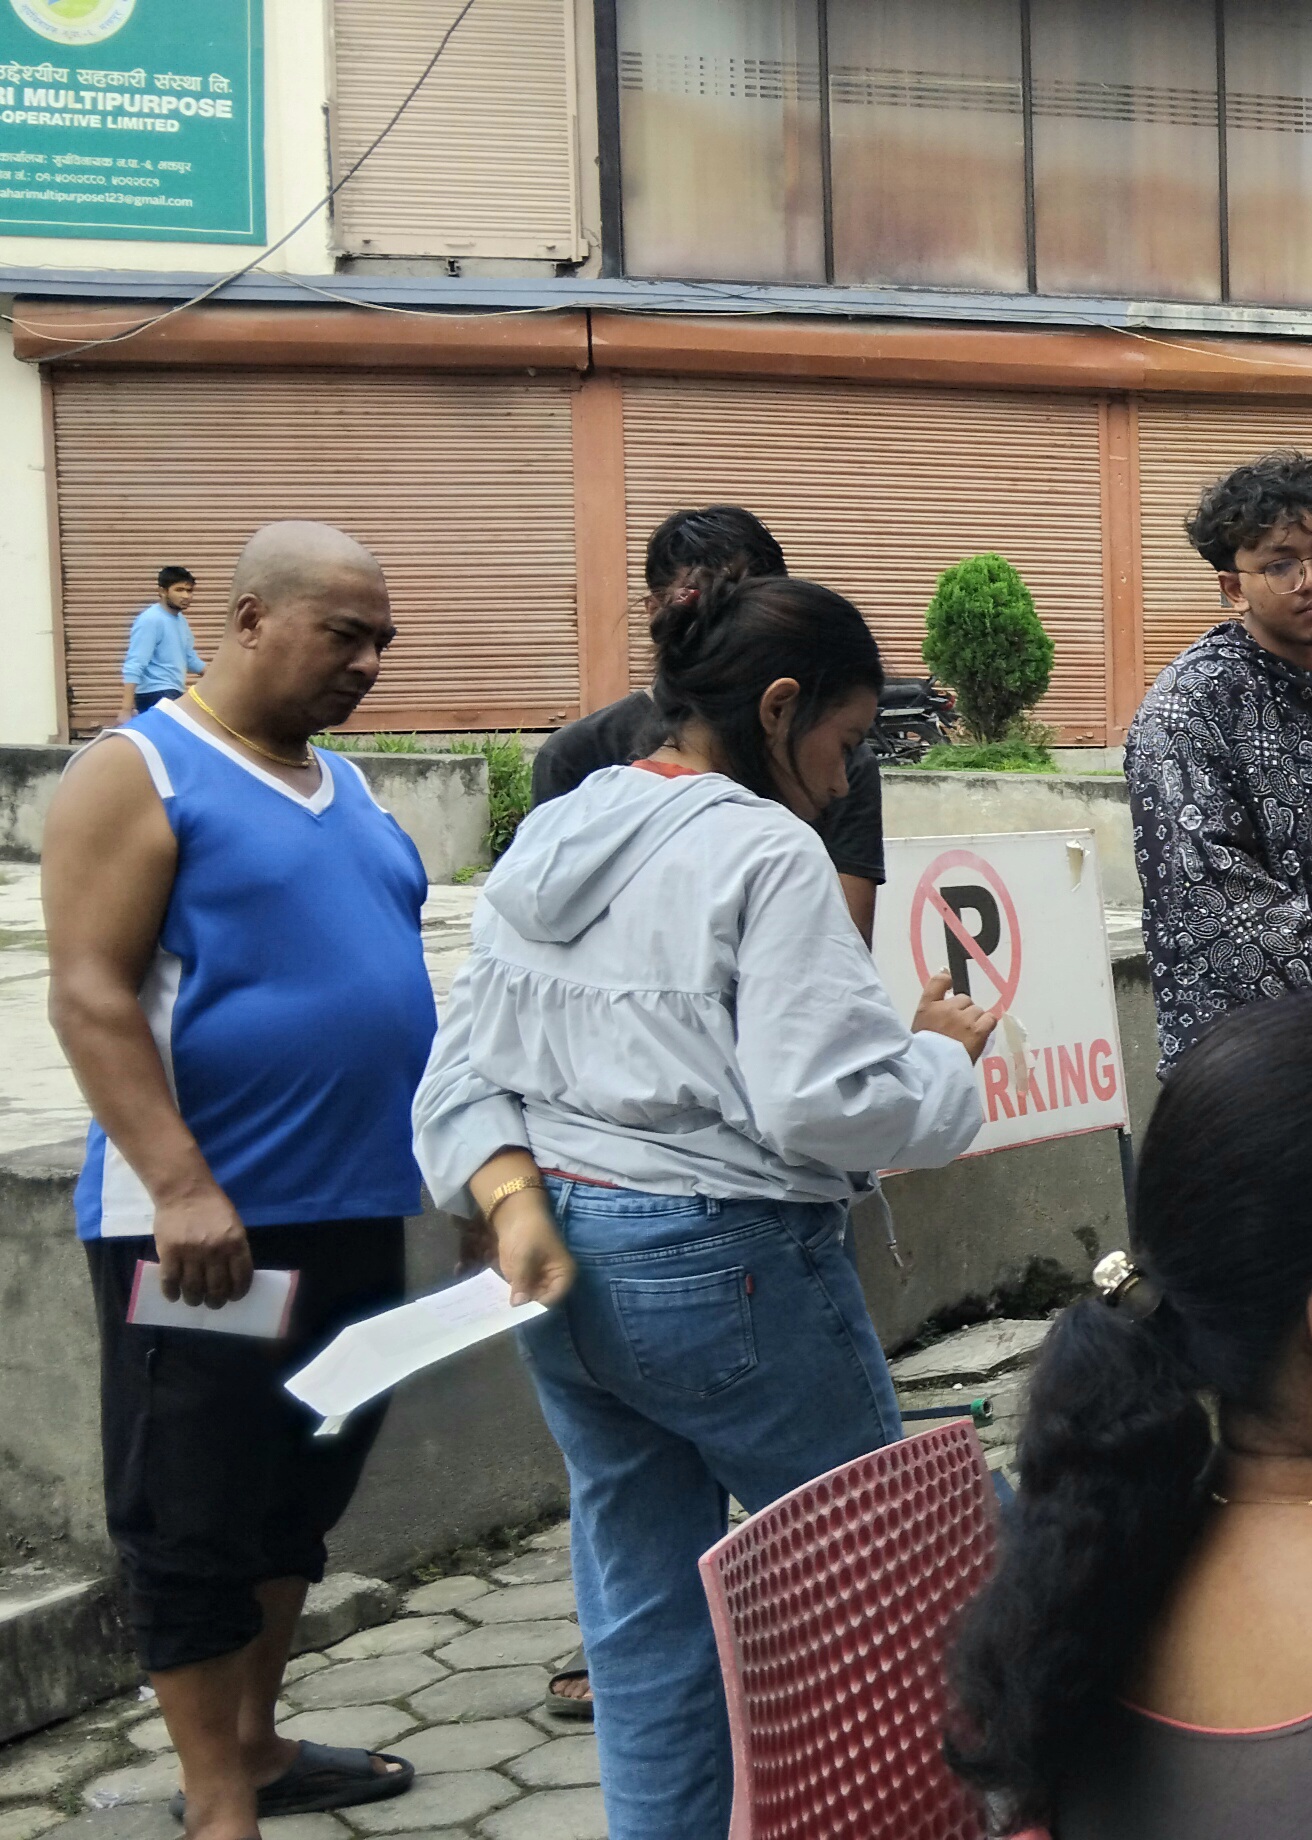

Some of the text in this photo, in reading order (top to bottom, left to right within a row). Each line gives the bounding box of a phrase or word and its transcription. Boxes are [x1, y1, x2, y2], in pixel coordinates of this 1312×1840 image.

[76, 68, 147, 88] सहकारी
[154, 72, 203, 91] संस्था
[24, 87, 233, 118] MULTIPURPOSE
[0, 110, 179, 132] OPERATIVE LIMITED
[940, 885, 1001, 997] P
[982, 1038, 1117, 1123] RKING
